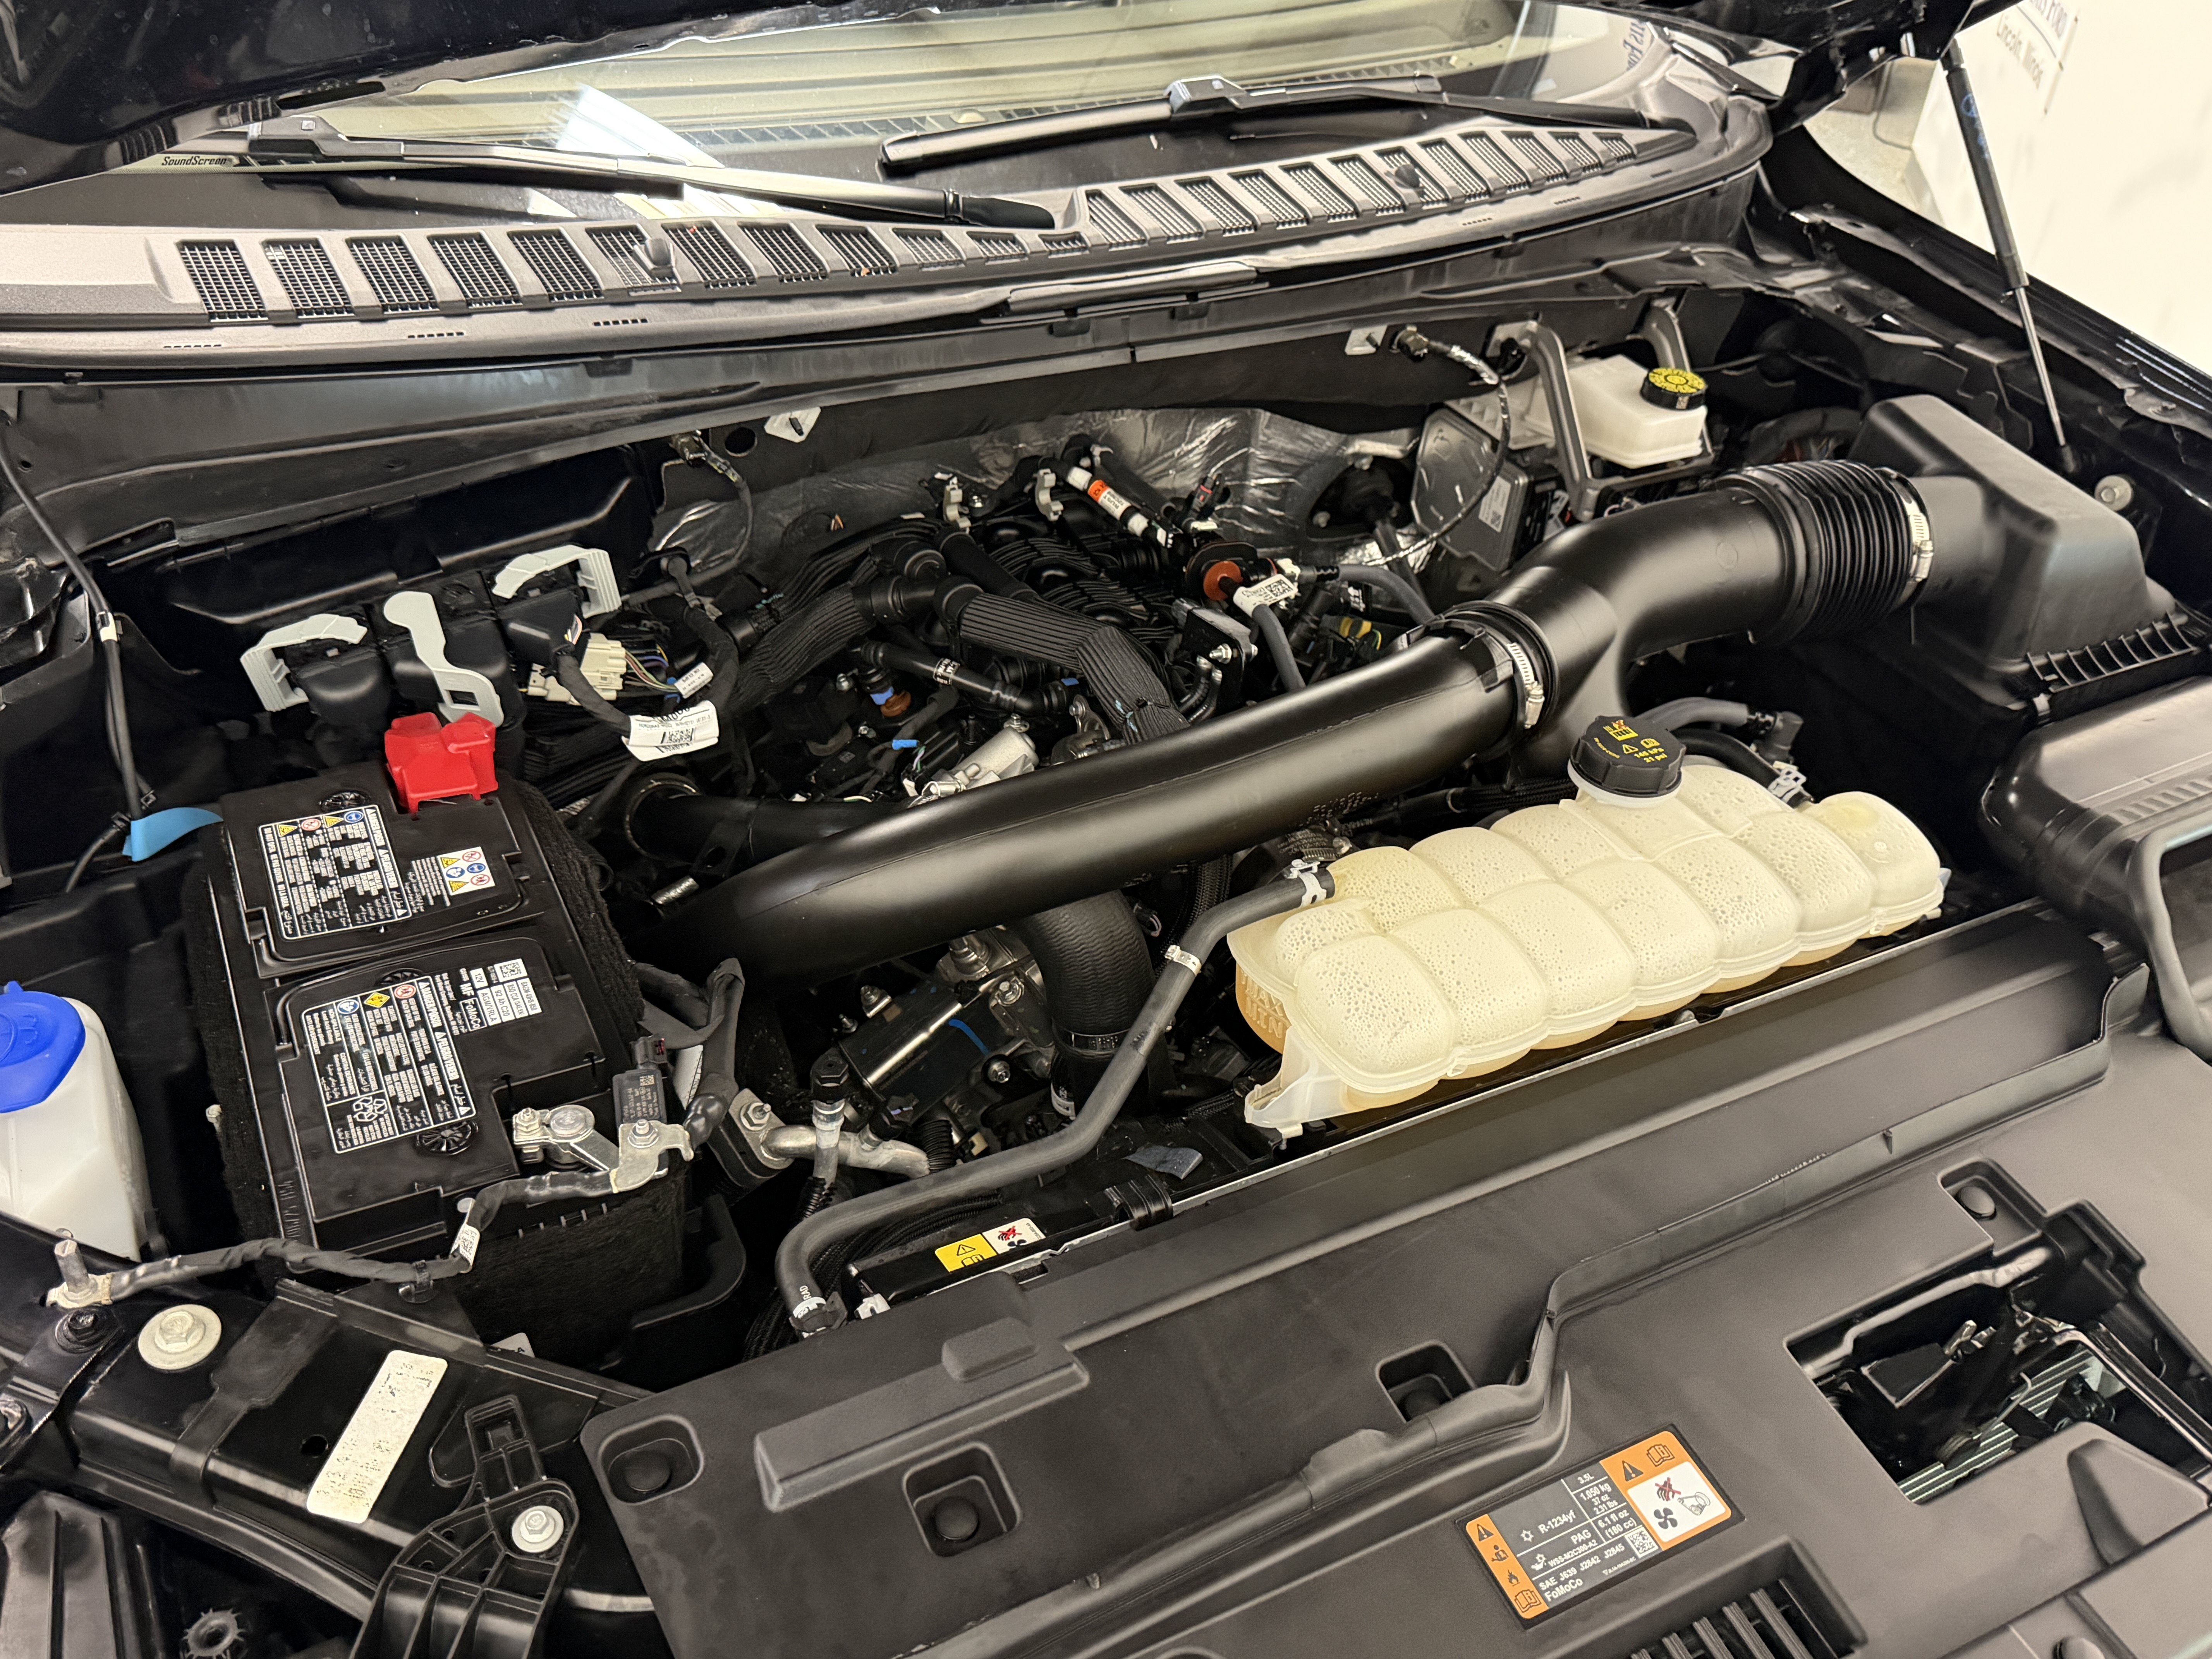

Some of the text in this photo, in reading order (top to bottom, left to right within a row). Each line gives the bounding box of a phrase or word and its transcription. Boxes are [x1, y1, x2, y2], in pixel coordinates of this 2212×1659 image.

[161, 156, 227, 166] SoundScreen
[474, 973, 484, 984] 12V
[459, 982, 474, 998] MF
[510, 992, 519, 1001] CCA
[420, 986, 442, 1028] DANGER/POISON
[481, 991, 498, 1022] AGM/VRLA
[497, 997, 505, 1005] Ah
[464, 999, 483, 1029] FoMoCo
[500, 1005, 510, 1017] C20
[436, 1037, 460, 1081] PELIGRO/VENENO
[800, 1285, 812, 1300] RAD
[1578, 1473, 1594, 1484] 3.5L
[1580, 1483, 1611, 1500] 1.050 kg
[1592, 1497, 1601, 1505] 37
[1594, 1504, 1607, 1515] 2.31
[1538, 1510, 1576, 1534] R-1234yf
[1598, 1510, 1629, 1528] 6.1 fl oz
[1605, 1517, 1637, 1539] (180 cc)
[1571, 1530, 1591, 1544] PAG
[1539, 1577, 1558, 1590] SAE
[1559, 1567, 1577, 1580] J639
[1580, 1556, 1601, 1571] J2842
[1604, 1543, 1625, 1558] J2845
[1544, 1578, 1583, 1601] FoMoCo
